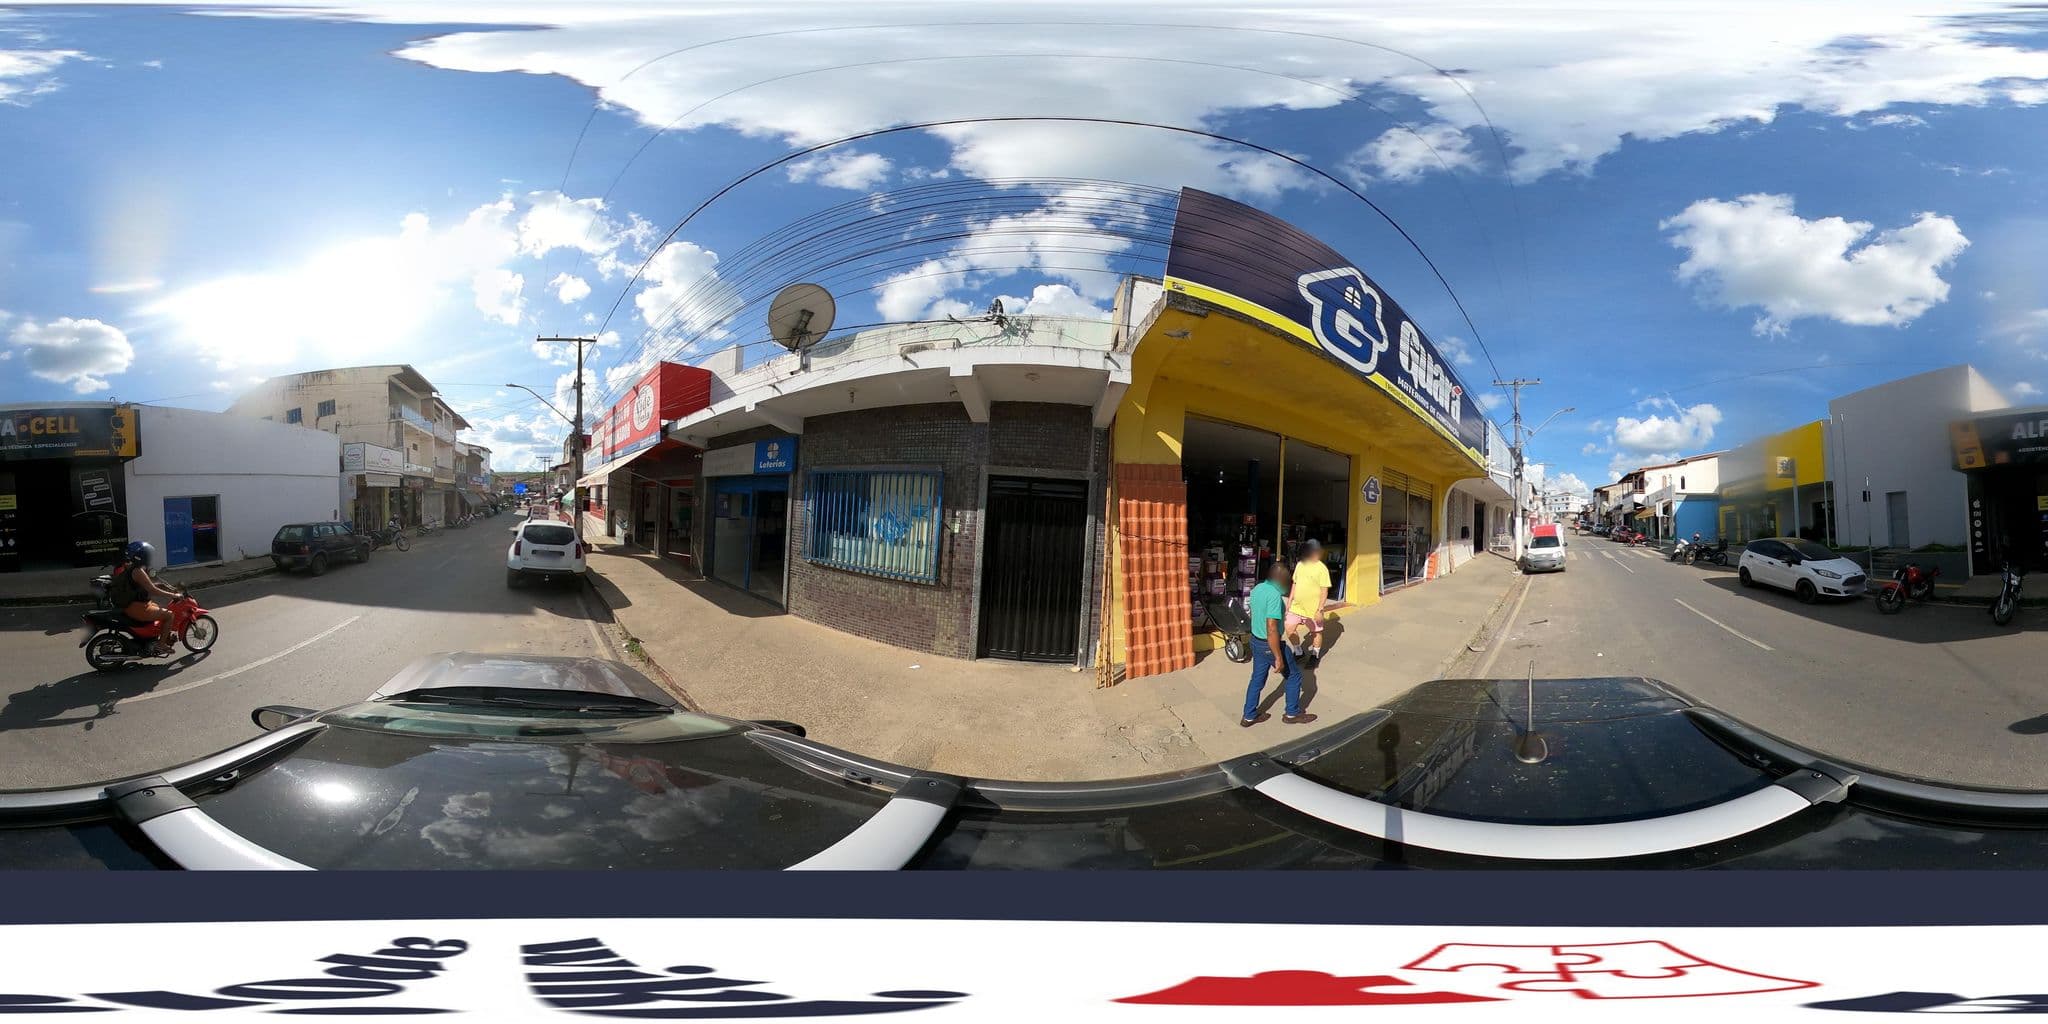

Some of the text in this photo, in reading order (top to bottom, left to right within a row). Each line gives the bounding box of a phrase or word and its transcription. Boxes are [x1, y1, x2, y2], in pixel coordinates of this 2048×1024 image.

[1399, 320, 1463, 425] Guará
[31, 415, 80, 435] CELL
[759, 459, 786, 470] Loterias
